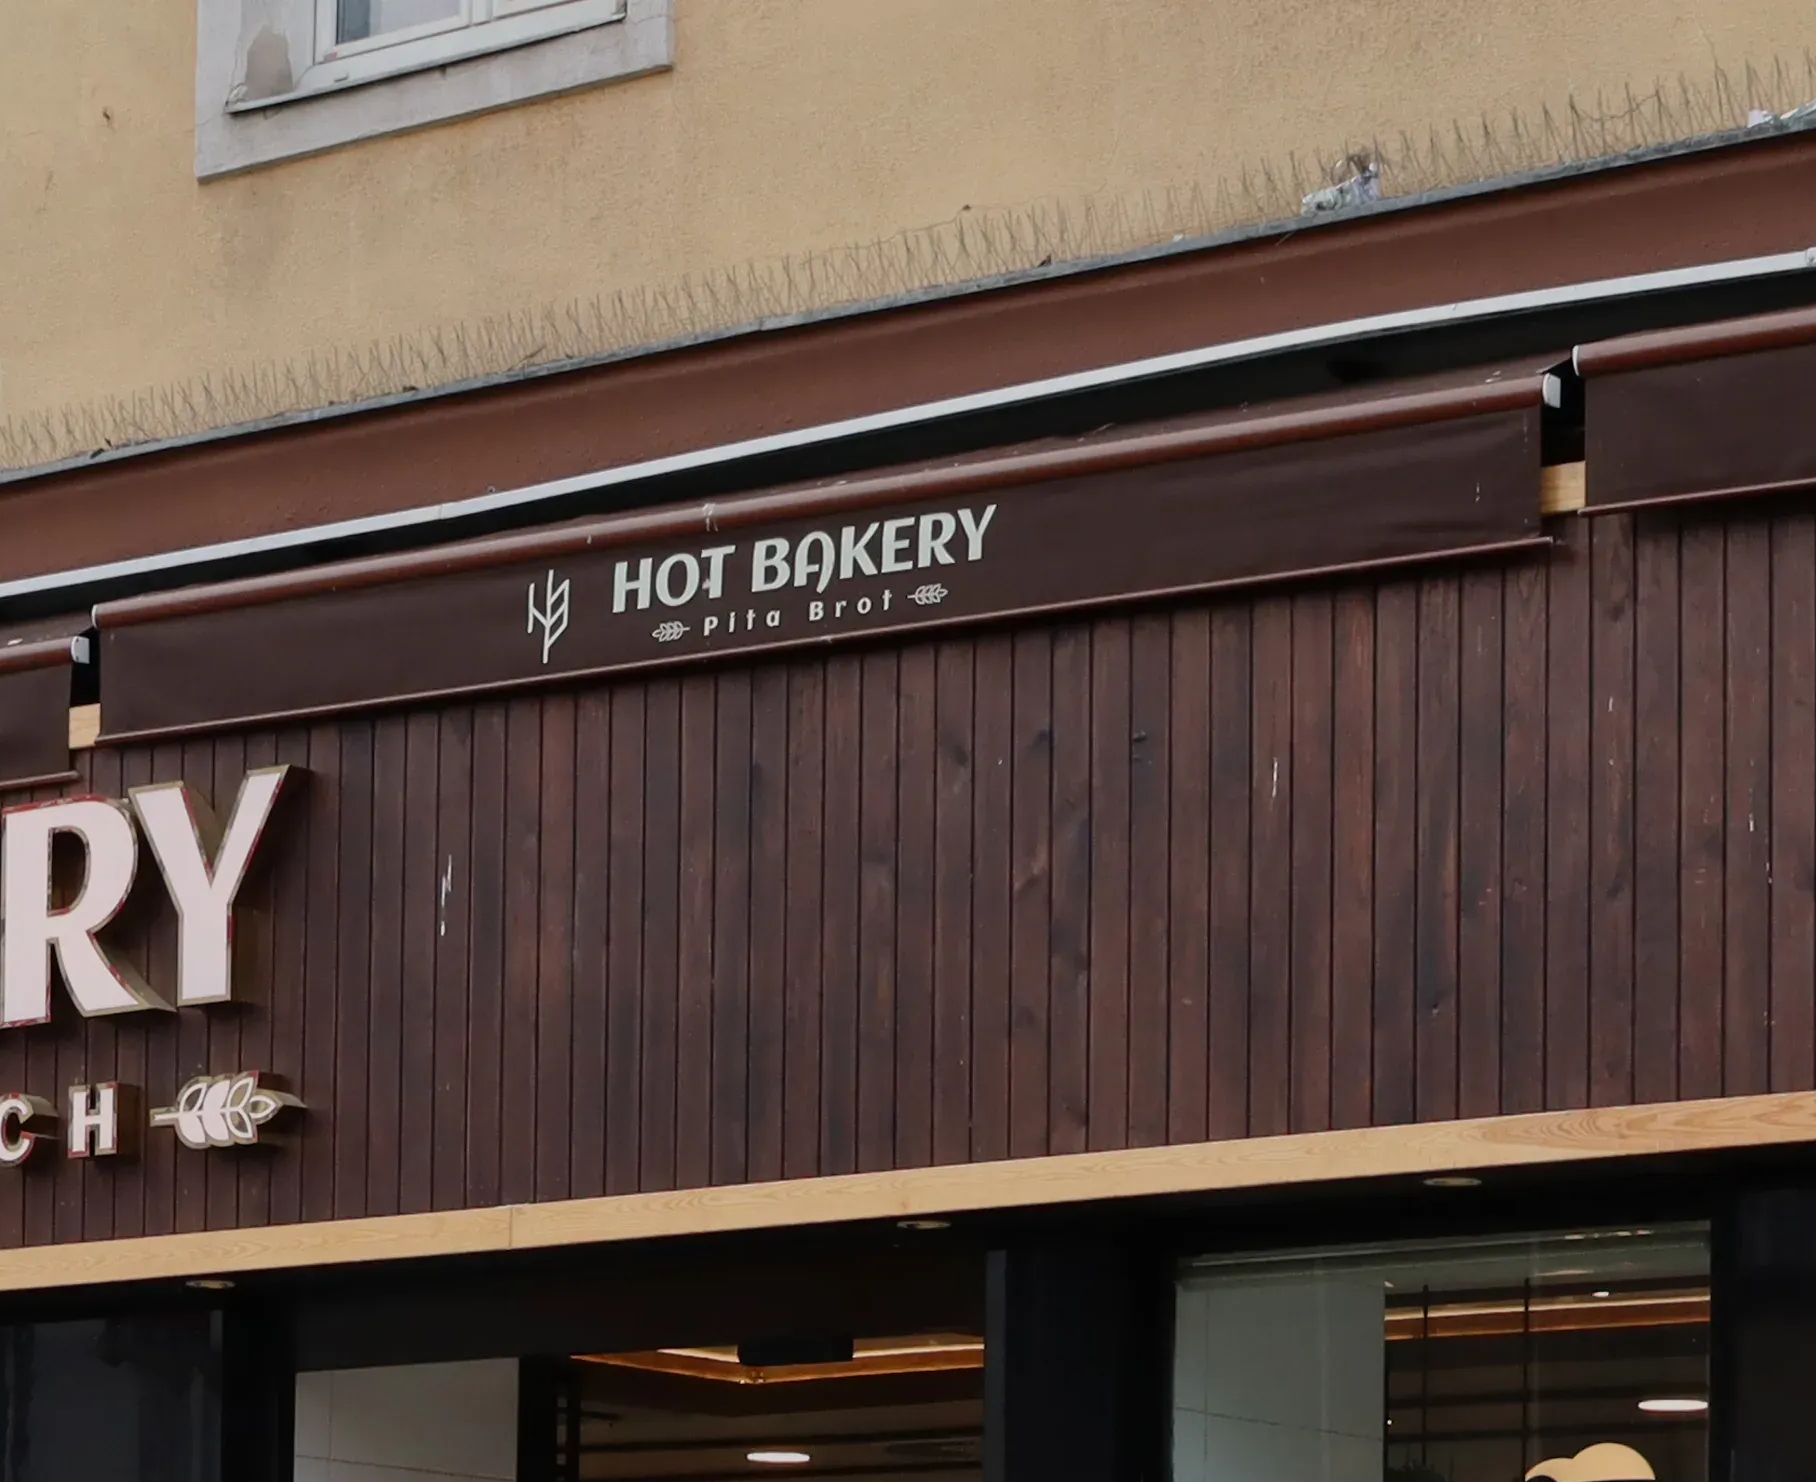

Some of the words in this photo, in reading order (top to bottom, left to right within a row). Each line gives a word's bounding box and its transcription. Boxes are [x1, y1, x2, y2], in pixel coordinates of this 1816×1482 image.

[611, 544, 736, 614] HOT
[750, 504, 998, 594] BAKERY
[702, 608, 781, 637] Pita
[808, 588, 893, 622] Brot
